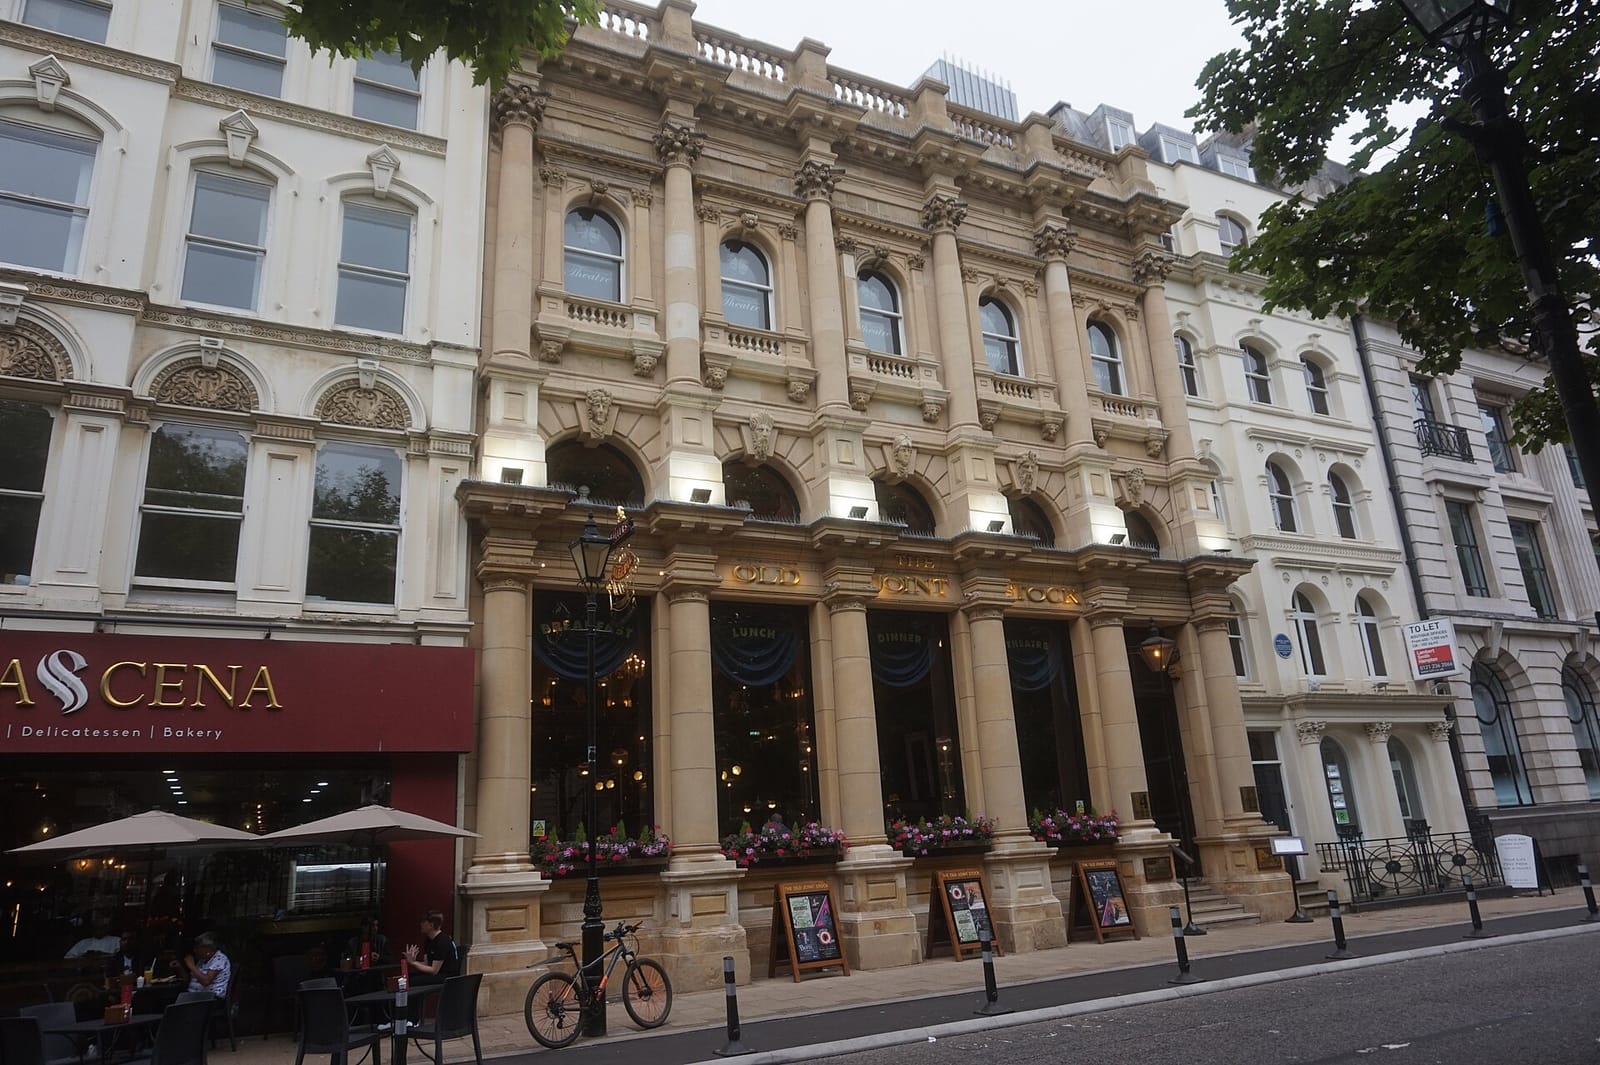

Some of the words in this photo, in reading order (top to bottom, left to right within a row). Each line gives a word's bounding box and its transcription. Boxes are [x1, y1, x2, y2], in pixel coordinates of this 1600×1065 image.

[567, 265, 611, 283] Theatre
[896, 554, 935, 568] THE
[732, 564, 800, 585] OLD
[732, 626, 776, 639] LUNCH
[1409, 625, 1421, 633] TO
[1422, 622, 1440, 631] LET
[878, 631, 922, 643] DINNER
[1006, 639, 1049, 650] THEATRE
[22, 726, 141, 737] Delicatessen
[164, 726, 223, 740] Bakery
